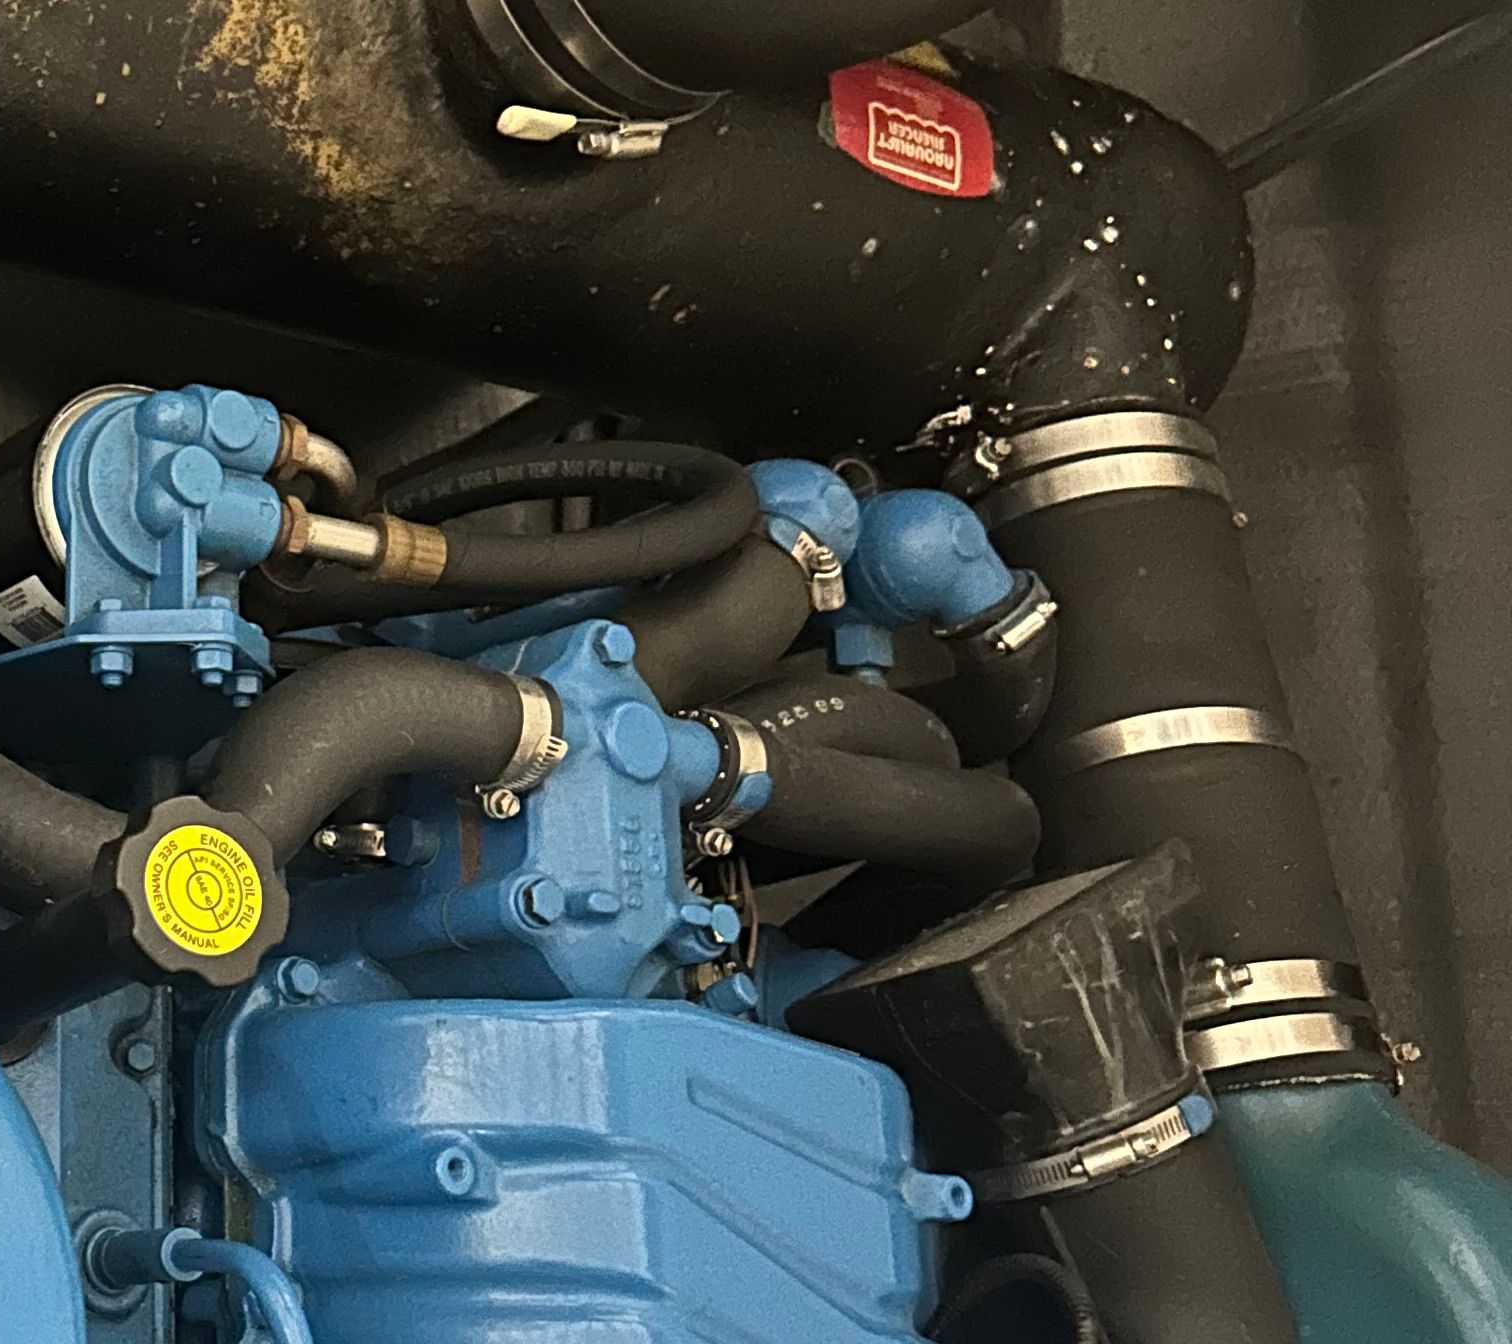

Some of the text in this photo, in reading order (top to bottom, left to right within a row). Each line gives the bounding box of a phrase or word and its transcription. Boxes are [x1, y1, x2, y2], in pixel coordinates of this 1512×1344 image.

[888, 122, 946, 151] SILENCER
[151, 840, 220, 949] SEE OWNER'S MANUAL
[195, 875, 209, 894] SAE
[200, 834, 256, 930] ENGINE OIL FILL
[210, 859, 236, 896] SERVICE
